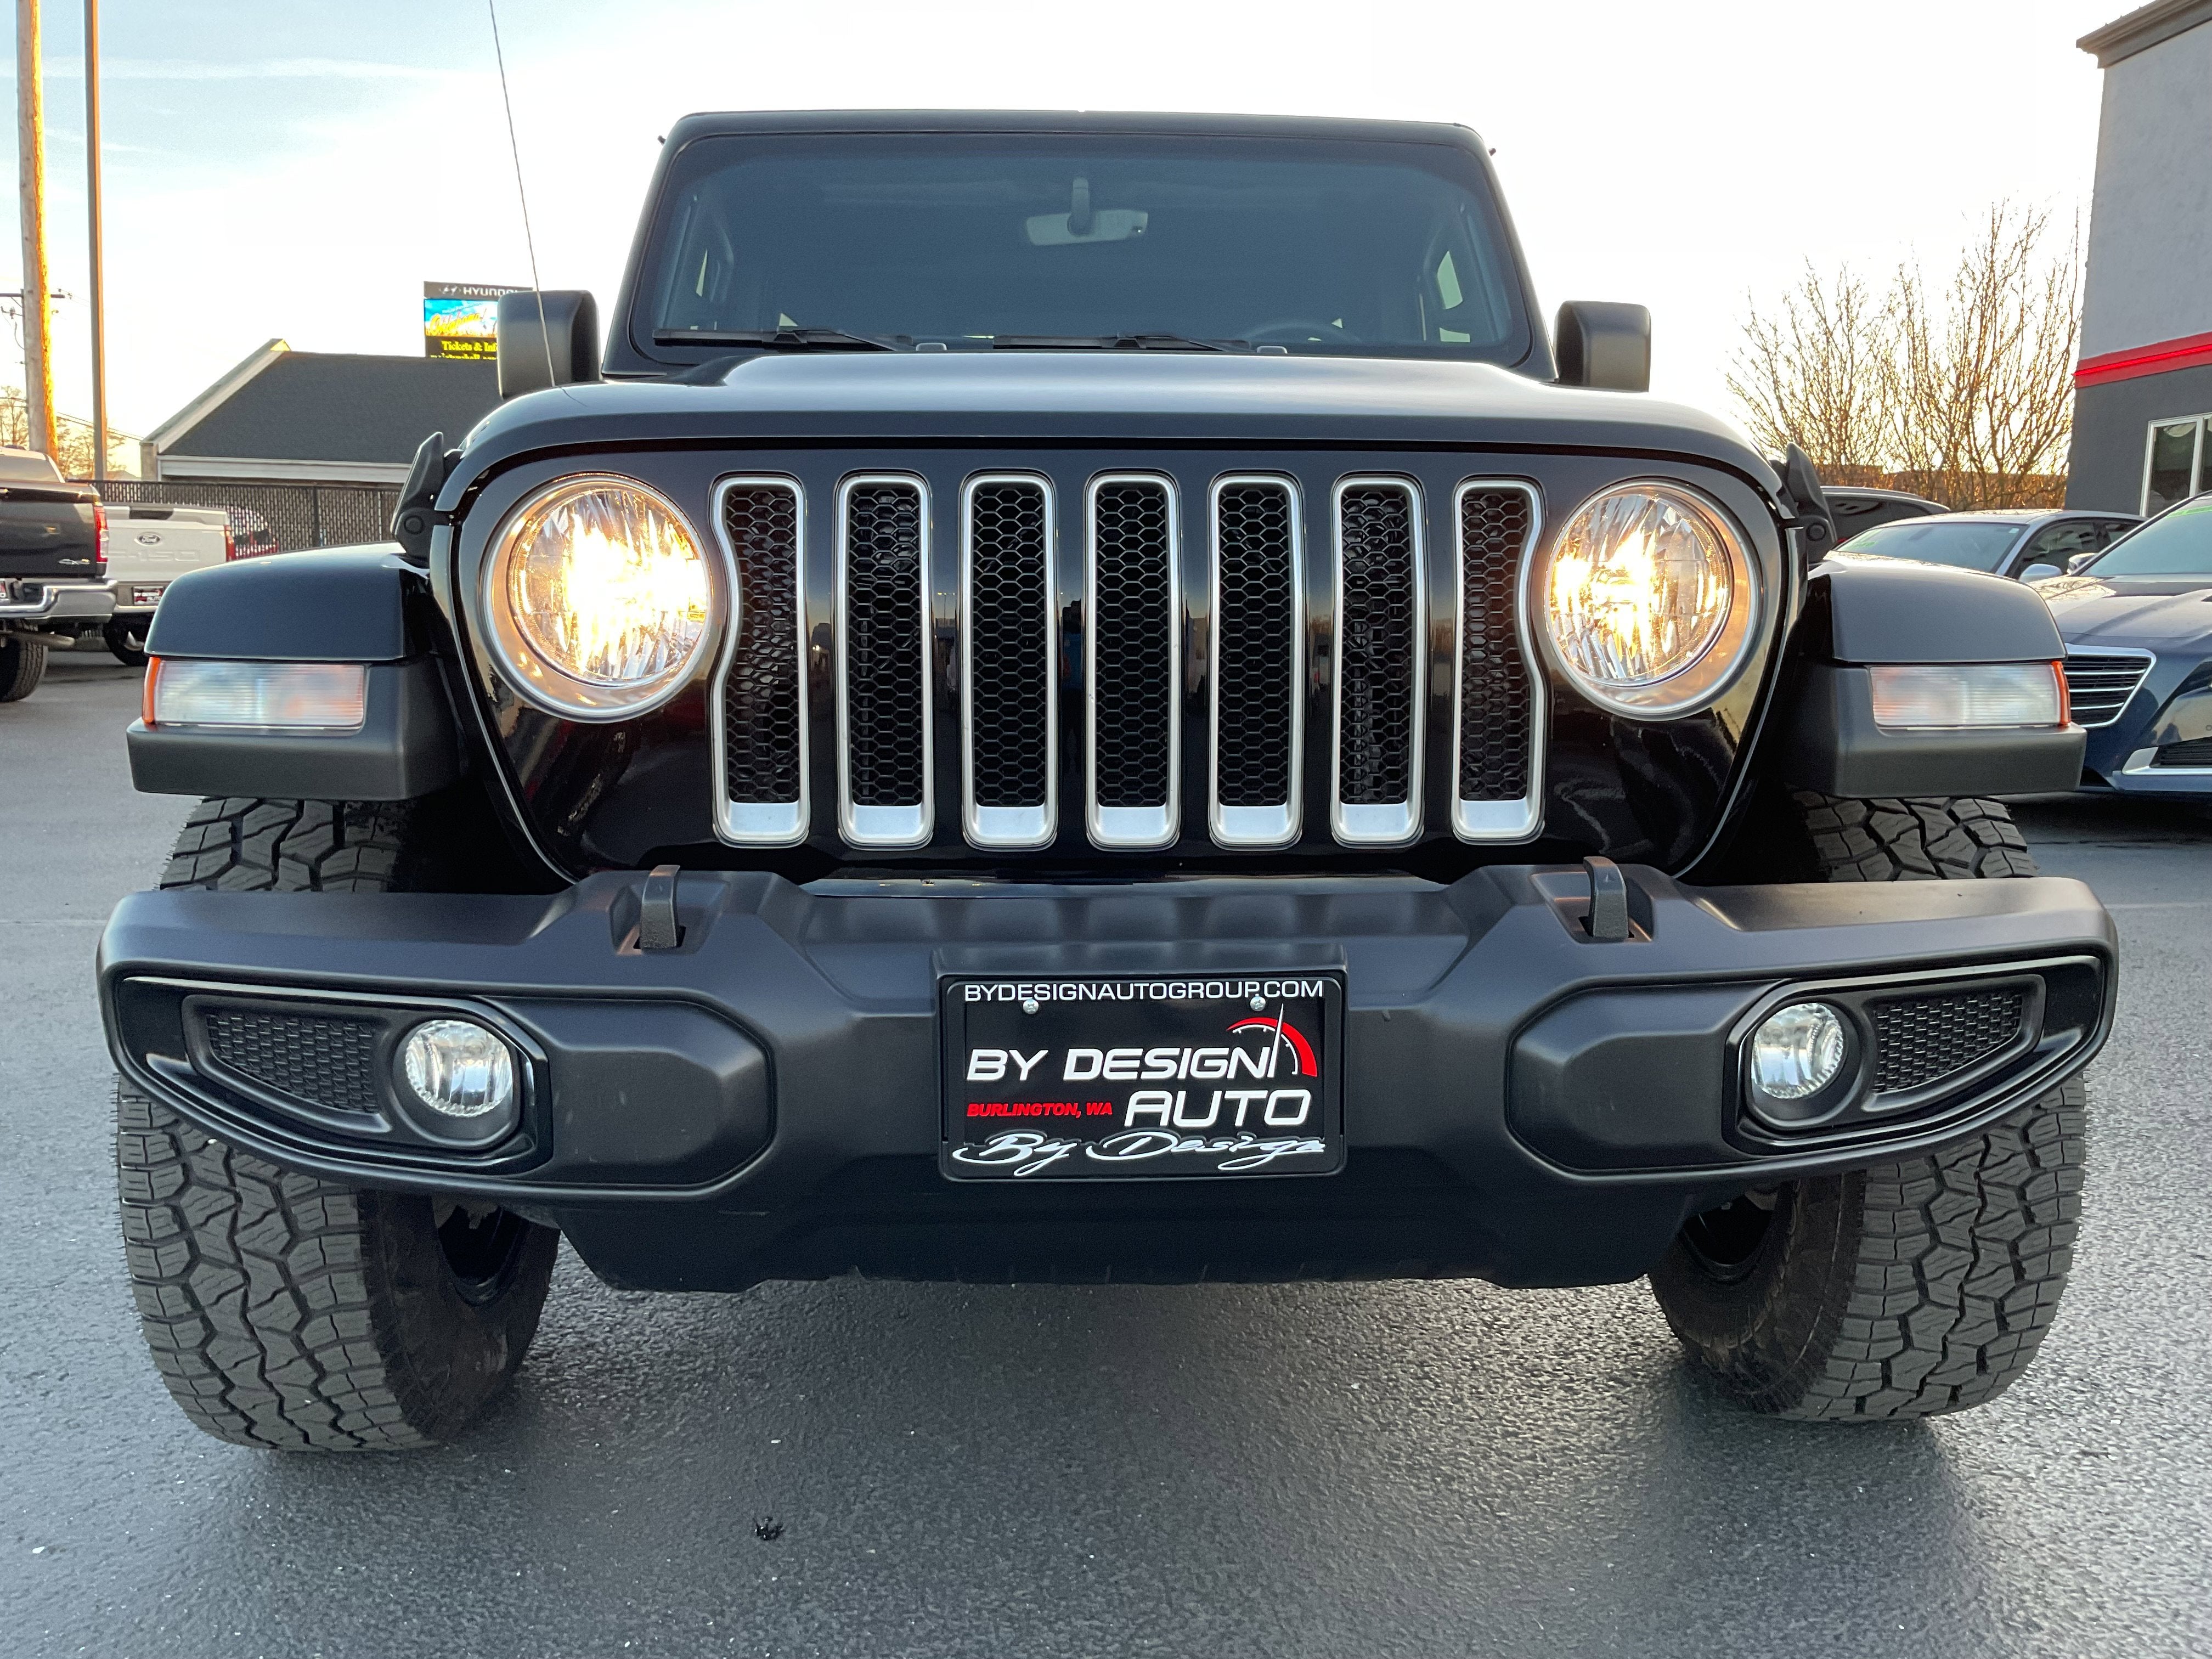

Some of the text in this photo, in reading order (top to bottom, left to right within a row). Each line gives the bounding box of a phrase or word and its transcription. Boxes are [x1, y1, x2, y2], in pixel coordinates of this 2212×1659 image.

[464, 286, 517, 296] HYUNDA
[441, 341, 498, 352] Tickets & Inf
[965, 980, 1323, 1001] BYDESIGNAUTOGROUP.COM
[967, 1047, 1271, 1081] BY DESIGN
[967, 1102, 1113, 1119] BURLINGTON, WA
[1124, 1088, 1312, 1127] AUTO
[952, 1131, 1326, 1176] By Design
